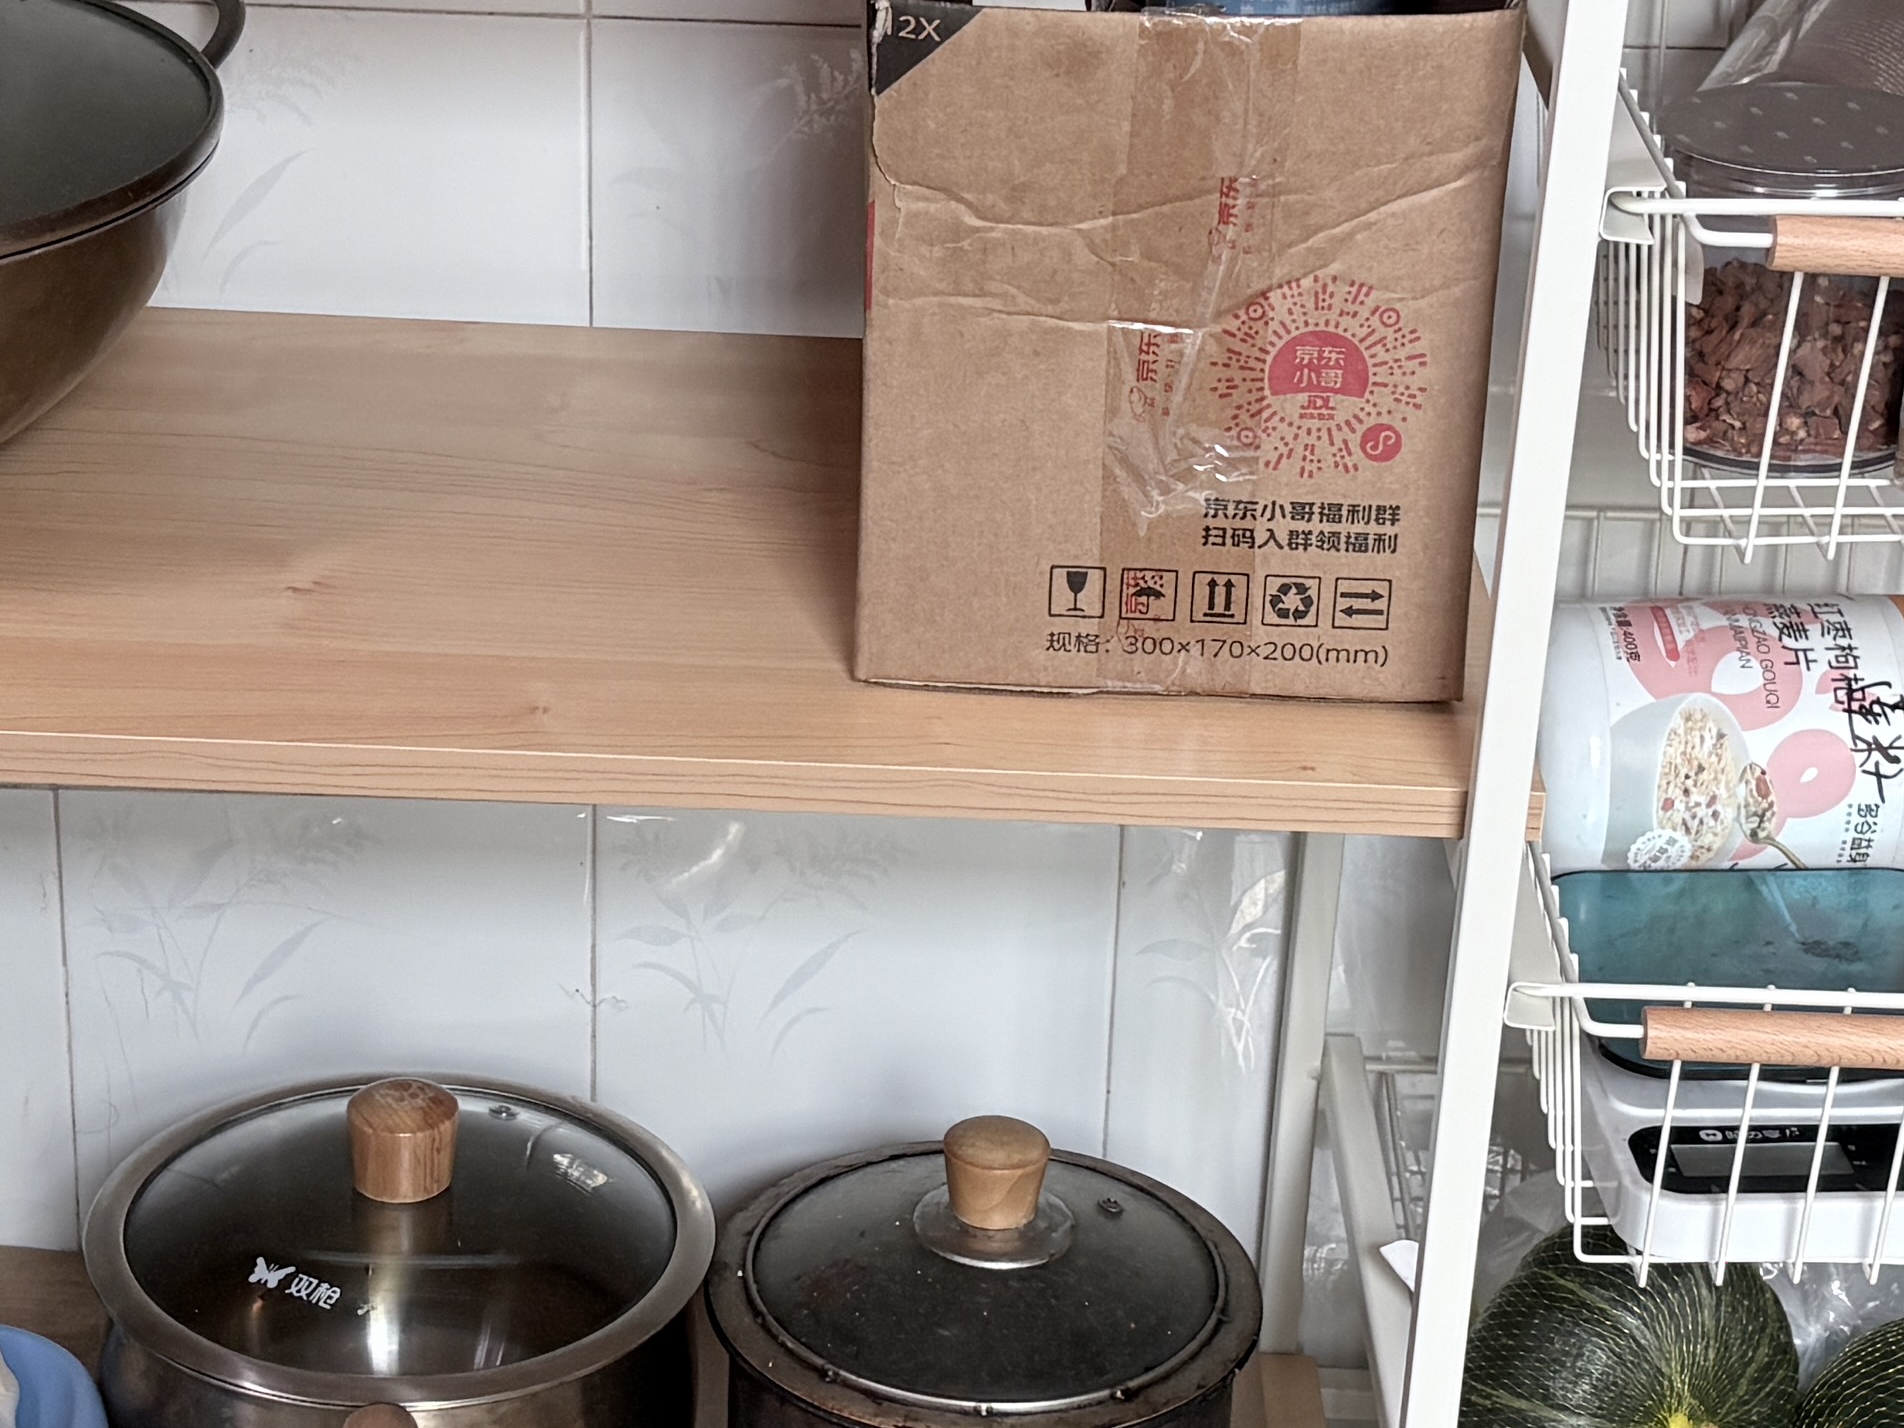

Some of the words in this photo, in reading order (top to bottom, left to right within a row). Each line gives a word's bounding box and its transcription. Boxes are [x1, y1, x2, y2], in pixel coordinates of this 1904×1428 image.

[1136, 332, 1161, 383] 京东
[1294, 346, 1346, 366] 京东
[1294, 368, 1344, 388] 小哥
[1300, 394, 1336, 410] JDL
[1203, 498, 1401, 527] 京东小哥福利群
[1201, 525, 1398, 555] 扫码入群领福利
[1764, 602, 1819, 671] 燕麦片
[1806, 602, 1866, 705] 红枣枸杞
[1759, 659, 1780, 710] GOUQI
[285, 1273, 341, 1309] 双枪
